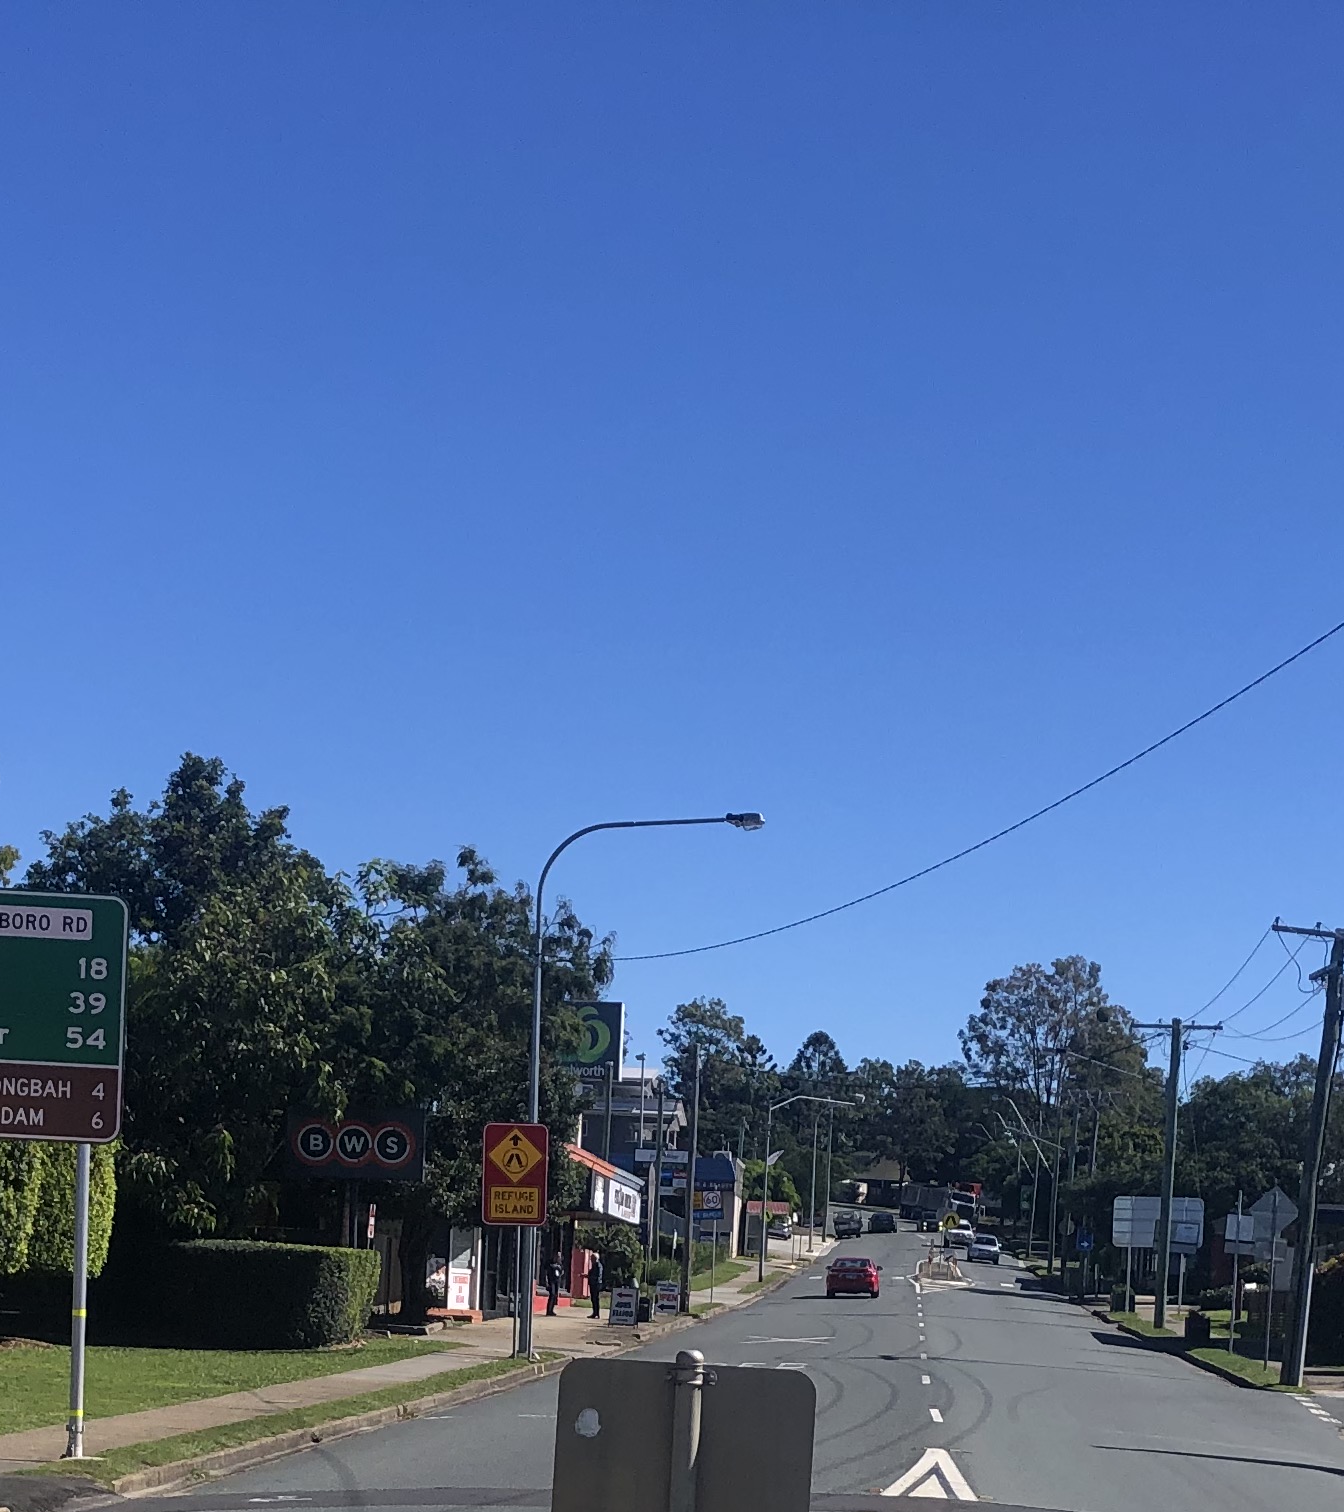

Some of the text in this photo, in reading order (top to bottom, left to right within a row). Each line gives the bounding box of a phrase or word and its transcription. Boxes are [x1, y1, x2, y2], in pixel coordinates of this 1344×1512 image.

[62, 916, 88, 933] RD
[78, 957, 108, 980] 18
[67, 991, 107, 1014] 39
[65, 1027, 106, 1050] 54
[91, 1082, 105, 1100] 4
[0, 1107, 45, 1126] DAM
[91, 1112, 104, 1129] 6
[309, 1134, 398, 1153] BWS
[494, 1190, 535, 1202] REFUGE
[704, 1196, 718, 1205] 60
[494, 1203, 534, 1215] ISLAND
